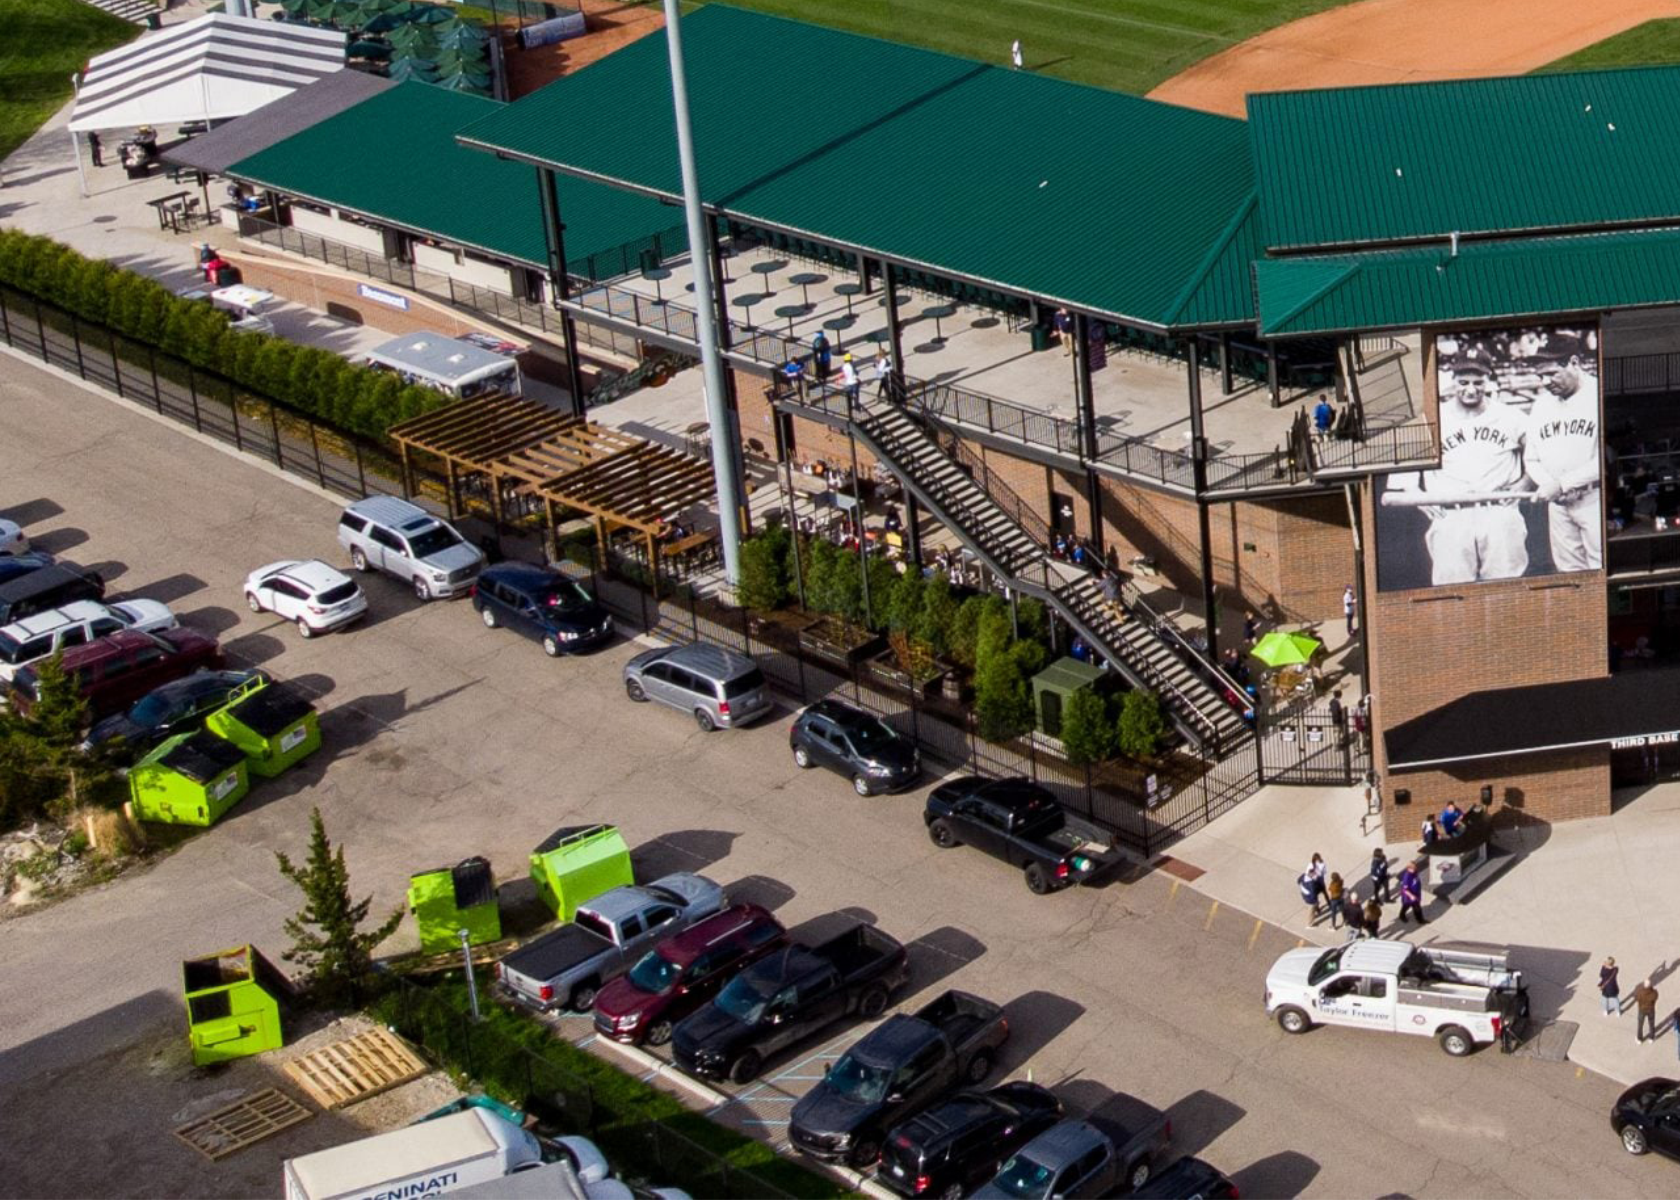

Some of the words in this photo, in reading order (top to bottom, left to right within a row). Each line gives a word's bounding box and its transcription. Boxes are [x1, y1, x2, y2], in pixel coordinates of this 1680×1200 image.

[1473, 426, 1509, 449] YORK
[1564, 418, 1596, 439] YORK
[1611, 736, 1646, 750] THIRD
[1647, 732, 1680, 746] BASE
[1319, 1004, 1349, 1016] Taylor
[1351, 1008, 1390, 1021] Freezer
[363, 1172, 458, 1200] ENINATI
